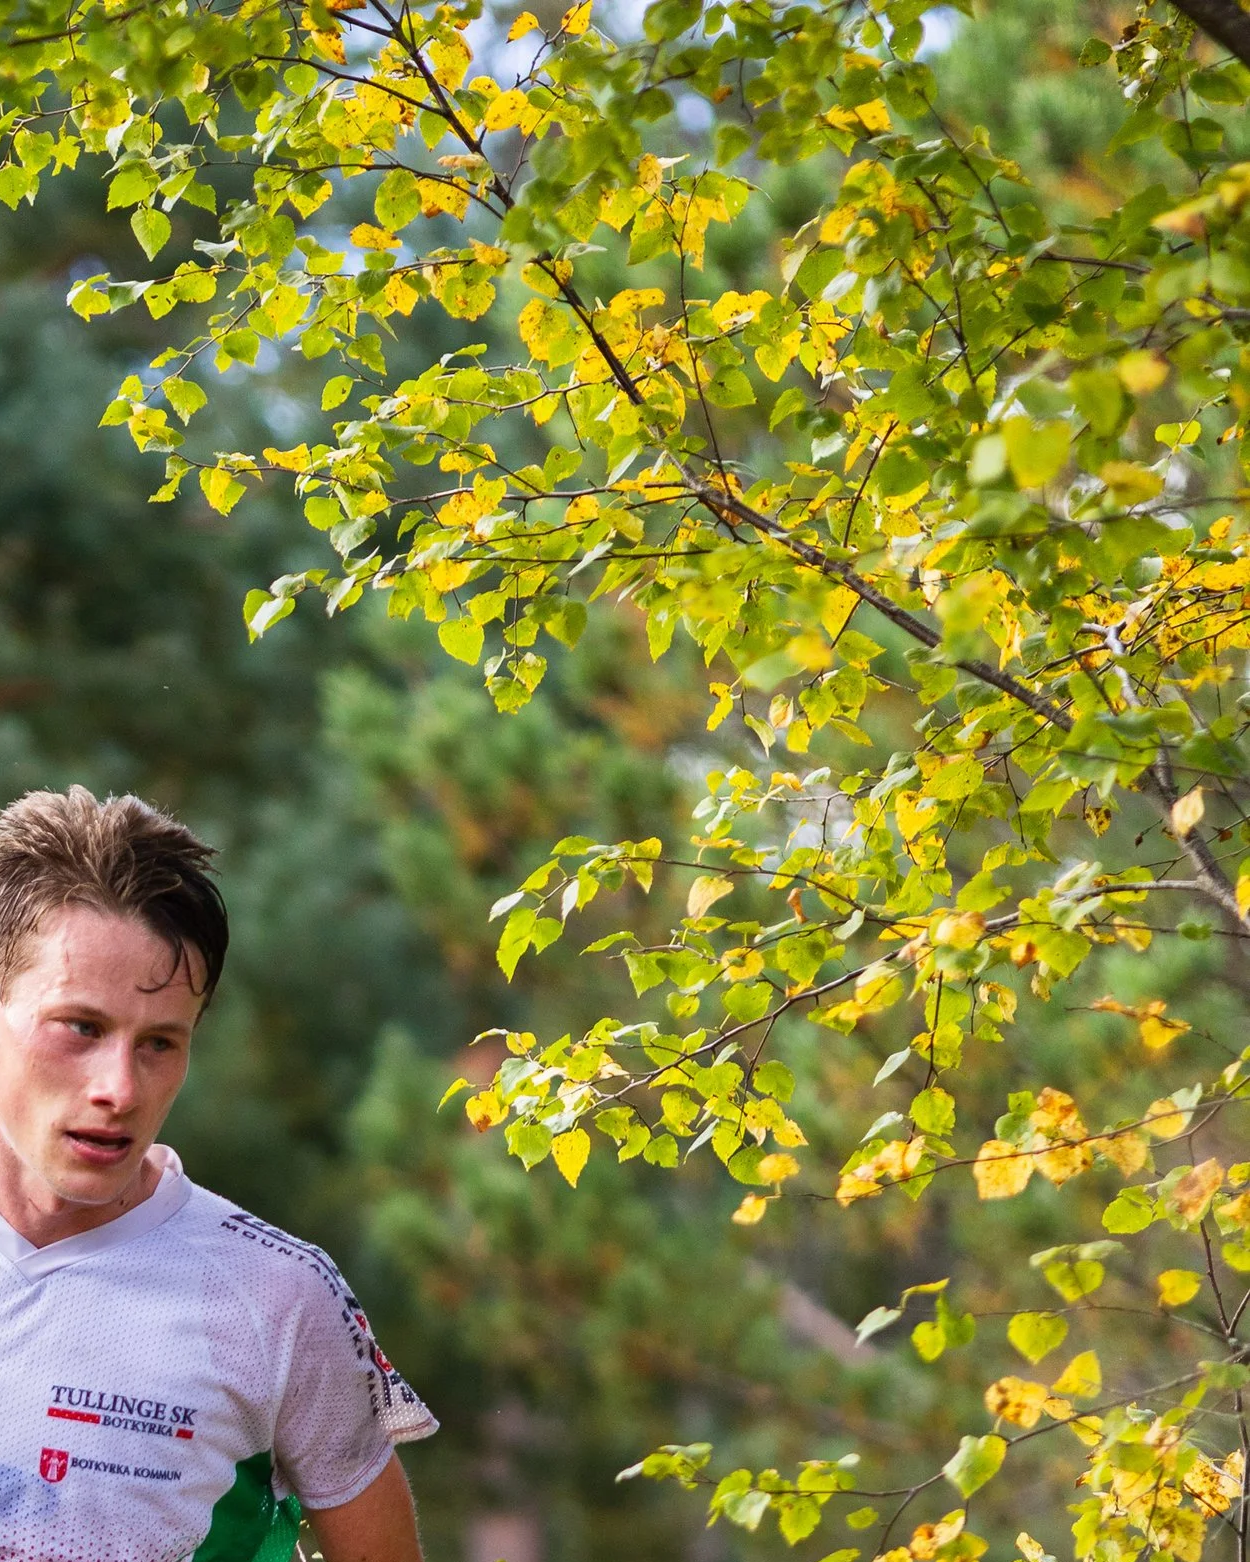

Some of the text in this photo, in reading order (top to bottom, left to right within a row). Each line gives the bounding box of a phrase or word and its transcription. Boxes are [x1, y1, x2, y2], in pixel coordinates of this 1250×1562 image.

[220, 1220, 339, 1297] MOUNTAIN
[50, 1385, 198, 1426] TULLINGE SK
[101, 1415, 174, 1438] BOTKYRKA
[71, 1457, 182, 1481] BOTKYRKA KOMMUN
